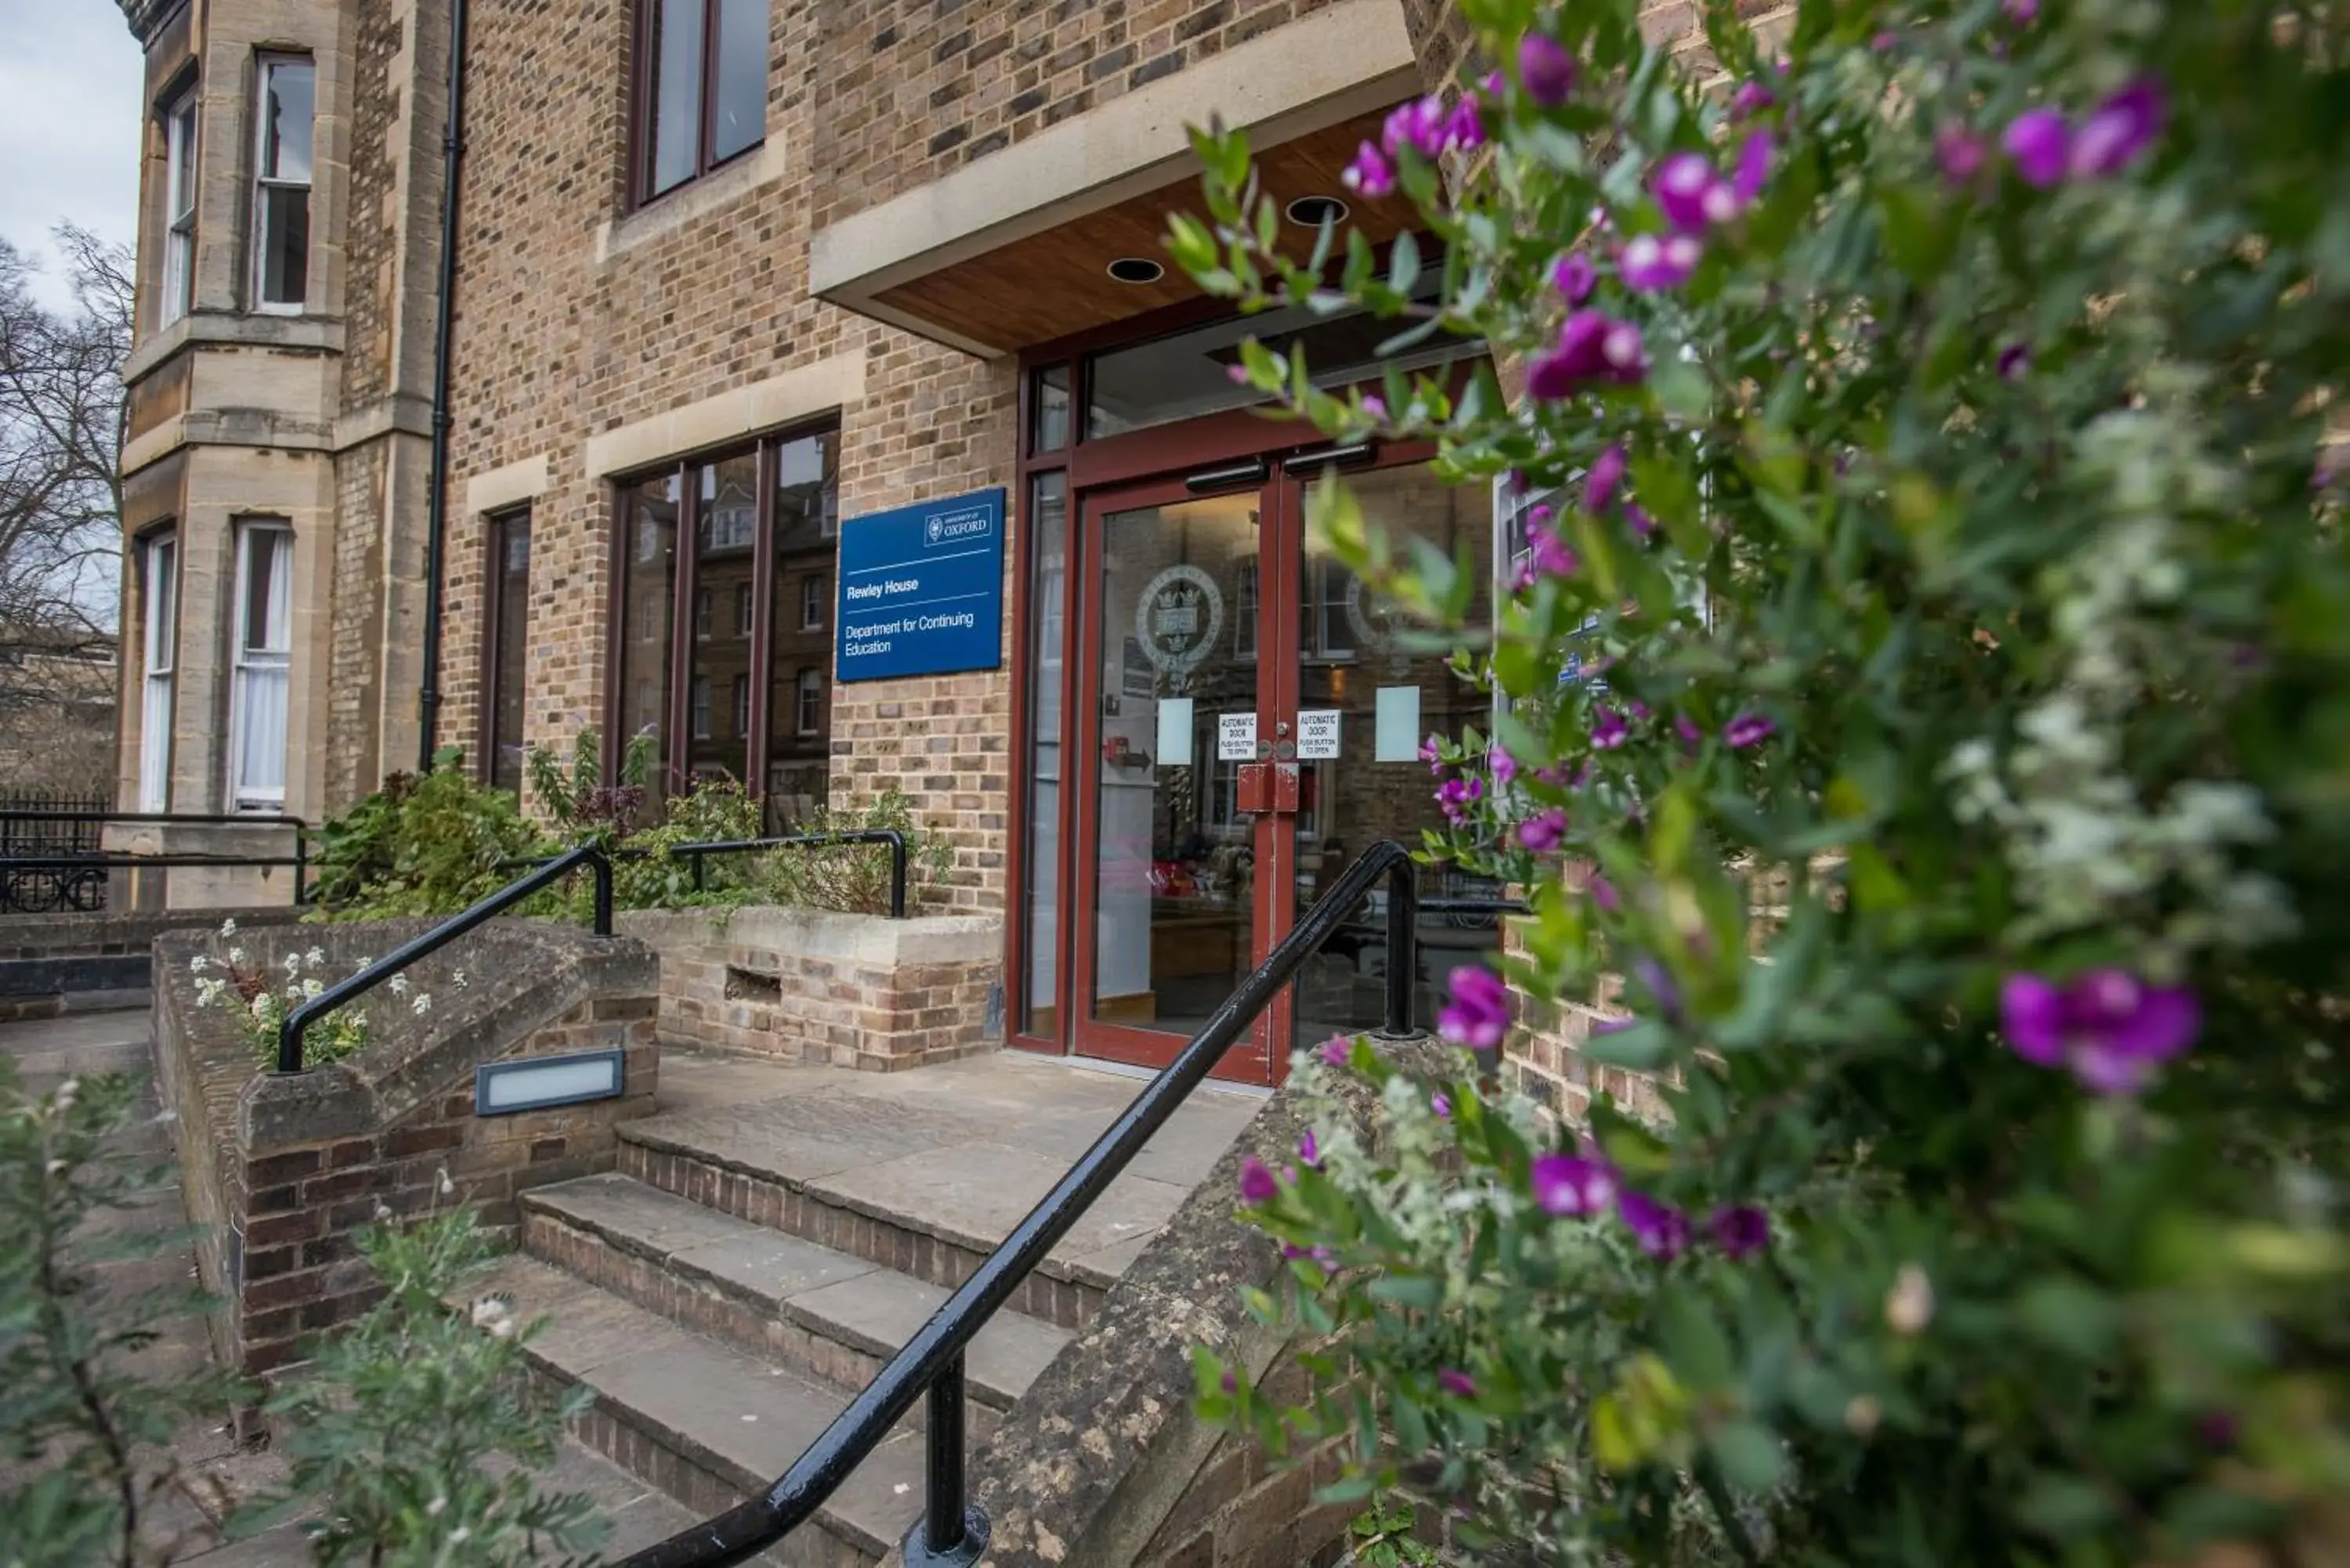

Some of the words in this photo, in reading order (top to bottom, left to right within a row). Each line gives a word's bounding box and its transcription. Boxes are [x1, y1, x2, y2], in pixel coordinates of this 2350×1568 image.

[944, 519, 986, 537] OXFORD
[847, 583, 882, 601] Rewley
[884, 578, 919, 594] House
[845, 622, 901, 641] Department
[902, 618, 916, 631] for
[919, 612, 974, 630] Continuing
[845, 641, 891, 656] Education
[1300, 715, 1336, 724] AUTOMATIC
